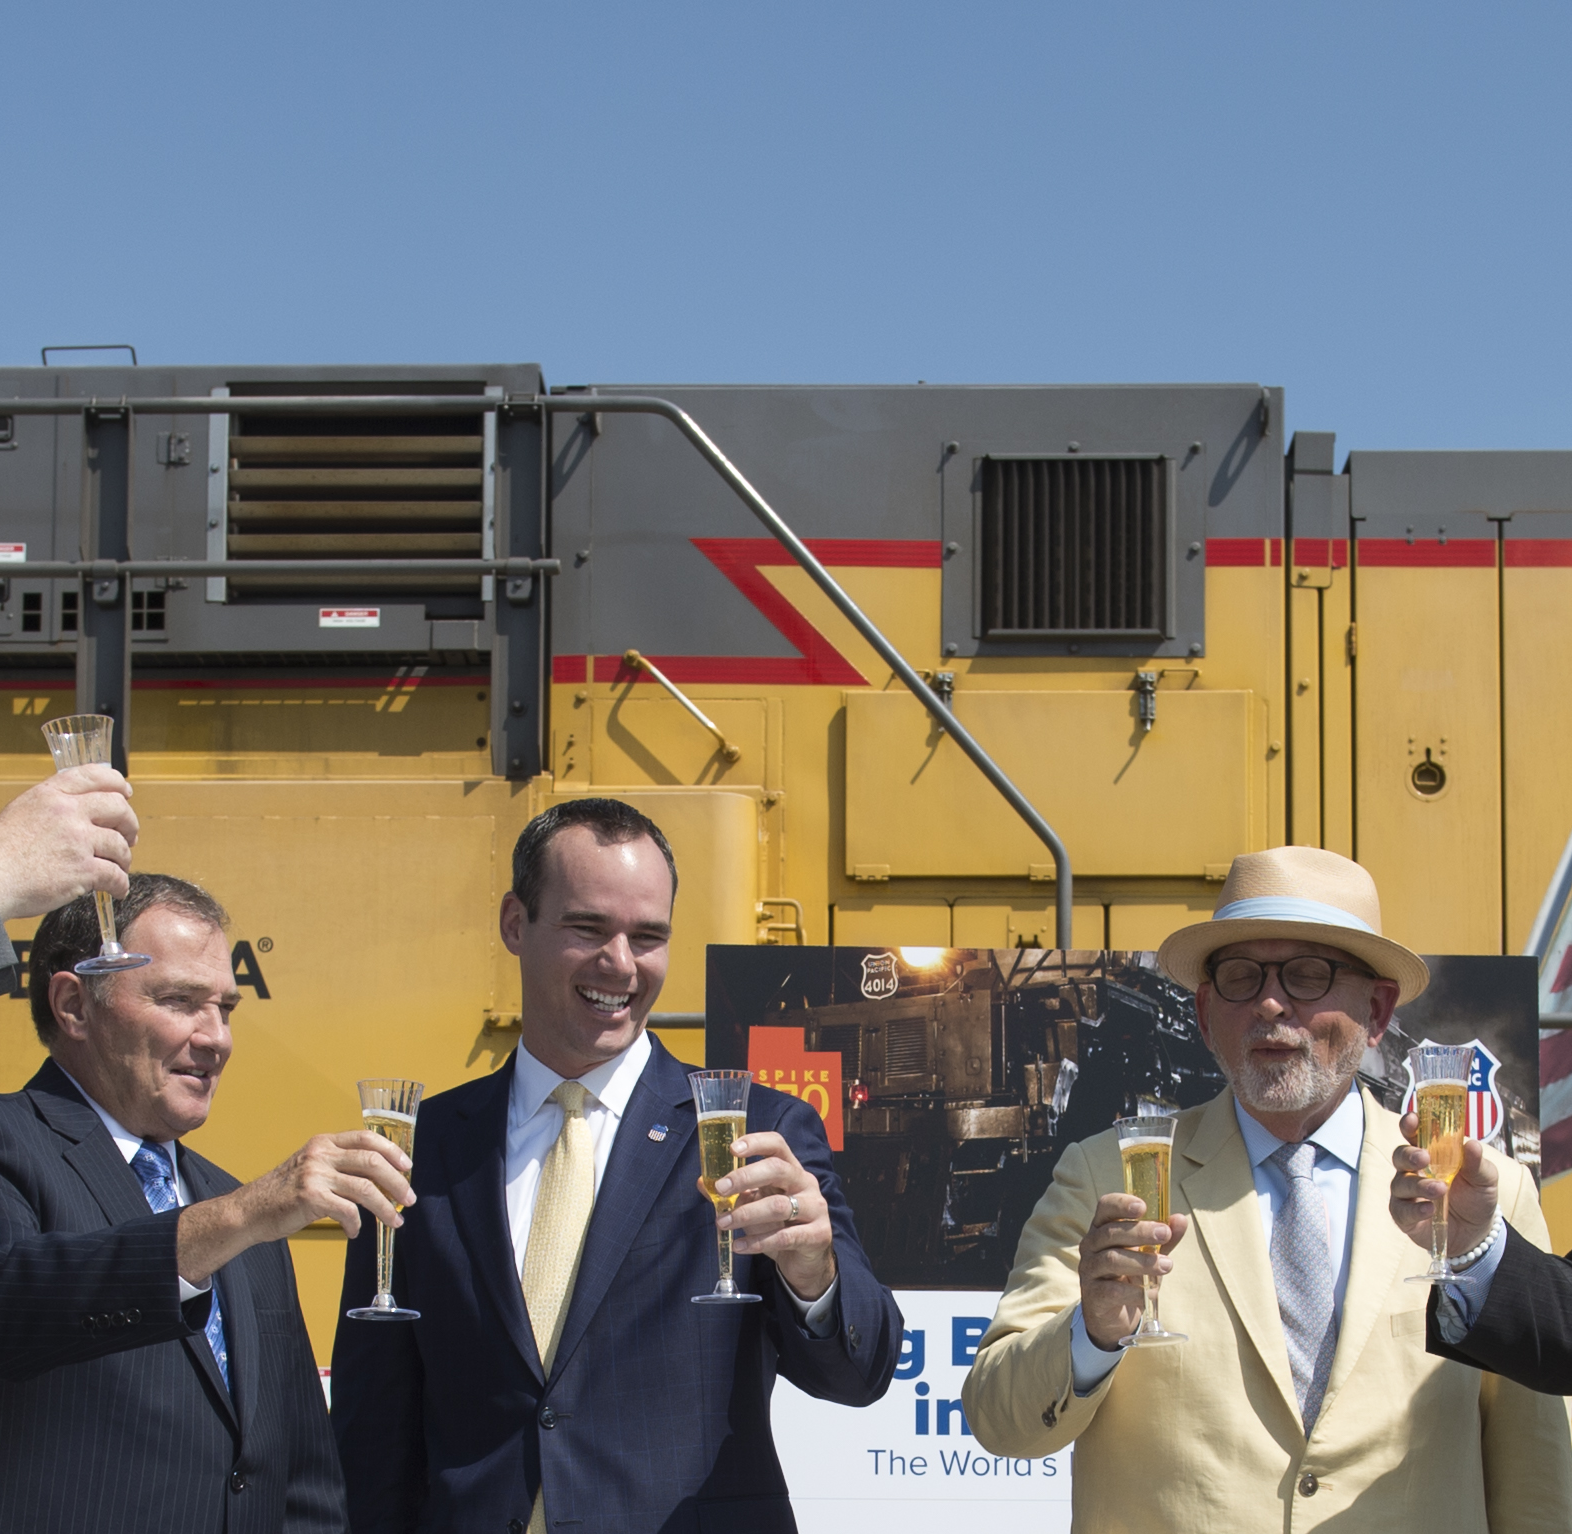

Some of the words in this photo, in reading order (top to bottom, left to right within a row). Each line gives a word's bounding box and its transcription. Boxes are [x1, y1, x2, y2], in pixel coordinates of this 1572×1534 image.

[865, 978, 894, 992] 4014
[758, 1069, 830, 1082] SPIKE
[867, 1449, 927, 1476] The
[939, 1450, 1057, 1477] Worlds
